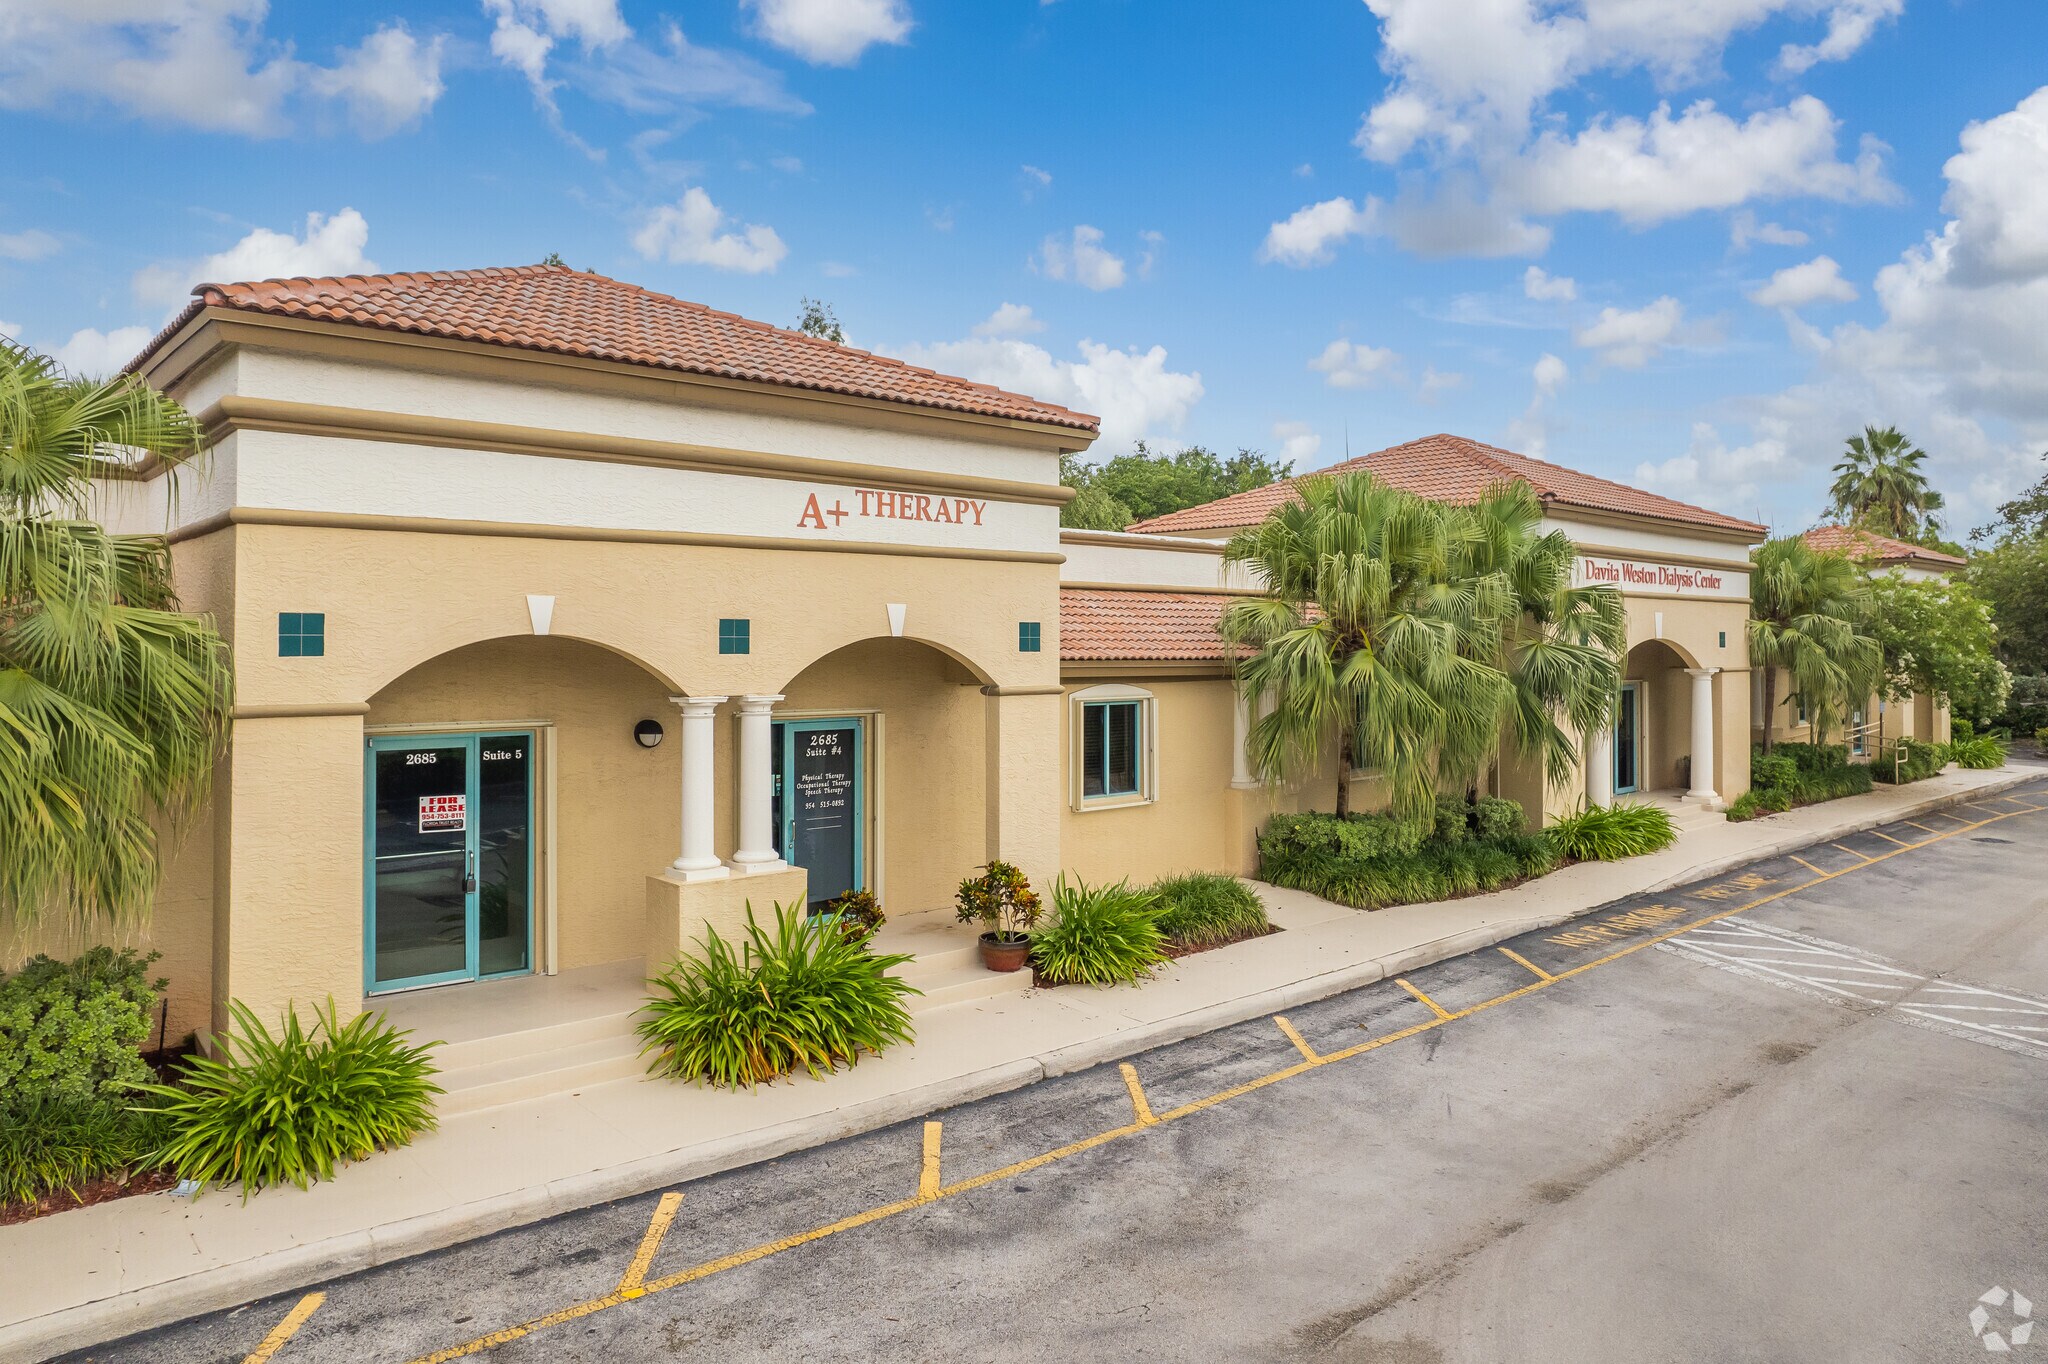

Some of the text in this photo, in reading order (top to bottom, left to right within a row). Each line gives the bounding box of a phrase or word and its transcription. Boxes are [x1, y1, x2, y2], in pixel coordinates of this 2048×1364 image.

[797, 489, 986, 529] A+ THERAPY
[1585, 559, 1722, 592] Davita Weston Dialysis Center
[810, 733, 838, 746] 2685
[483, 749, 522, 761] Suite 5
[806, 746, 842, 757] Suite #4
[406, 753, 437, 765] 2685
[801, 772, 845, 783] Physical Therapy
[796, 779, 852, 790] Occupational Therapy
[804, 787, 844, 797] Speech Therapy
[429, 797, 458, 805] FOR
[421, 804, 466, 813] LEASE
